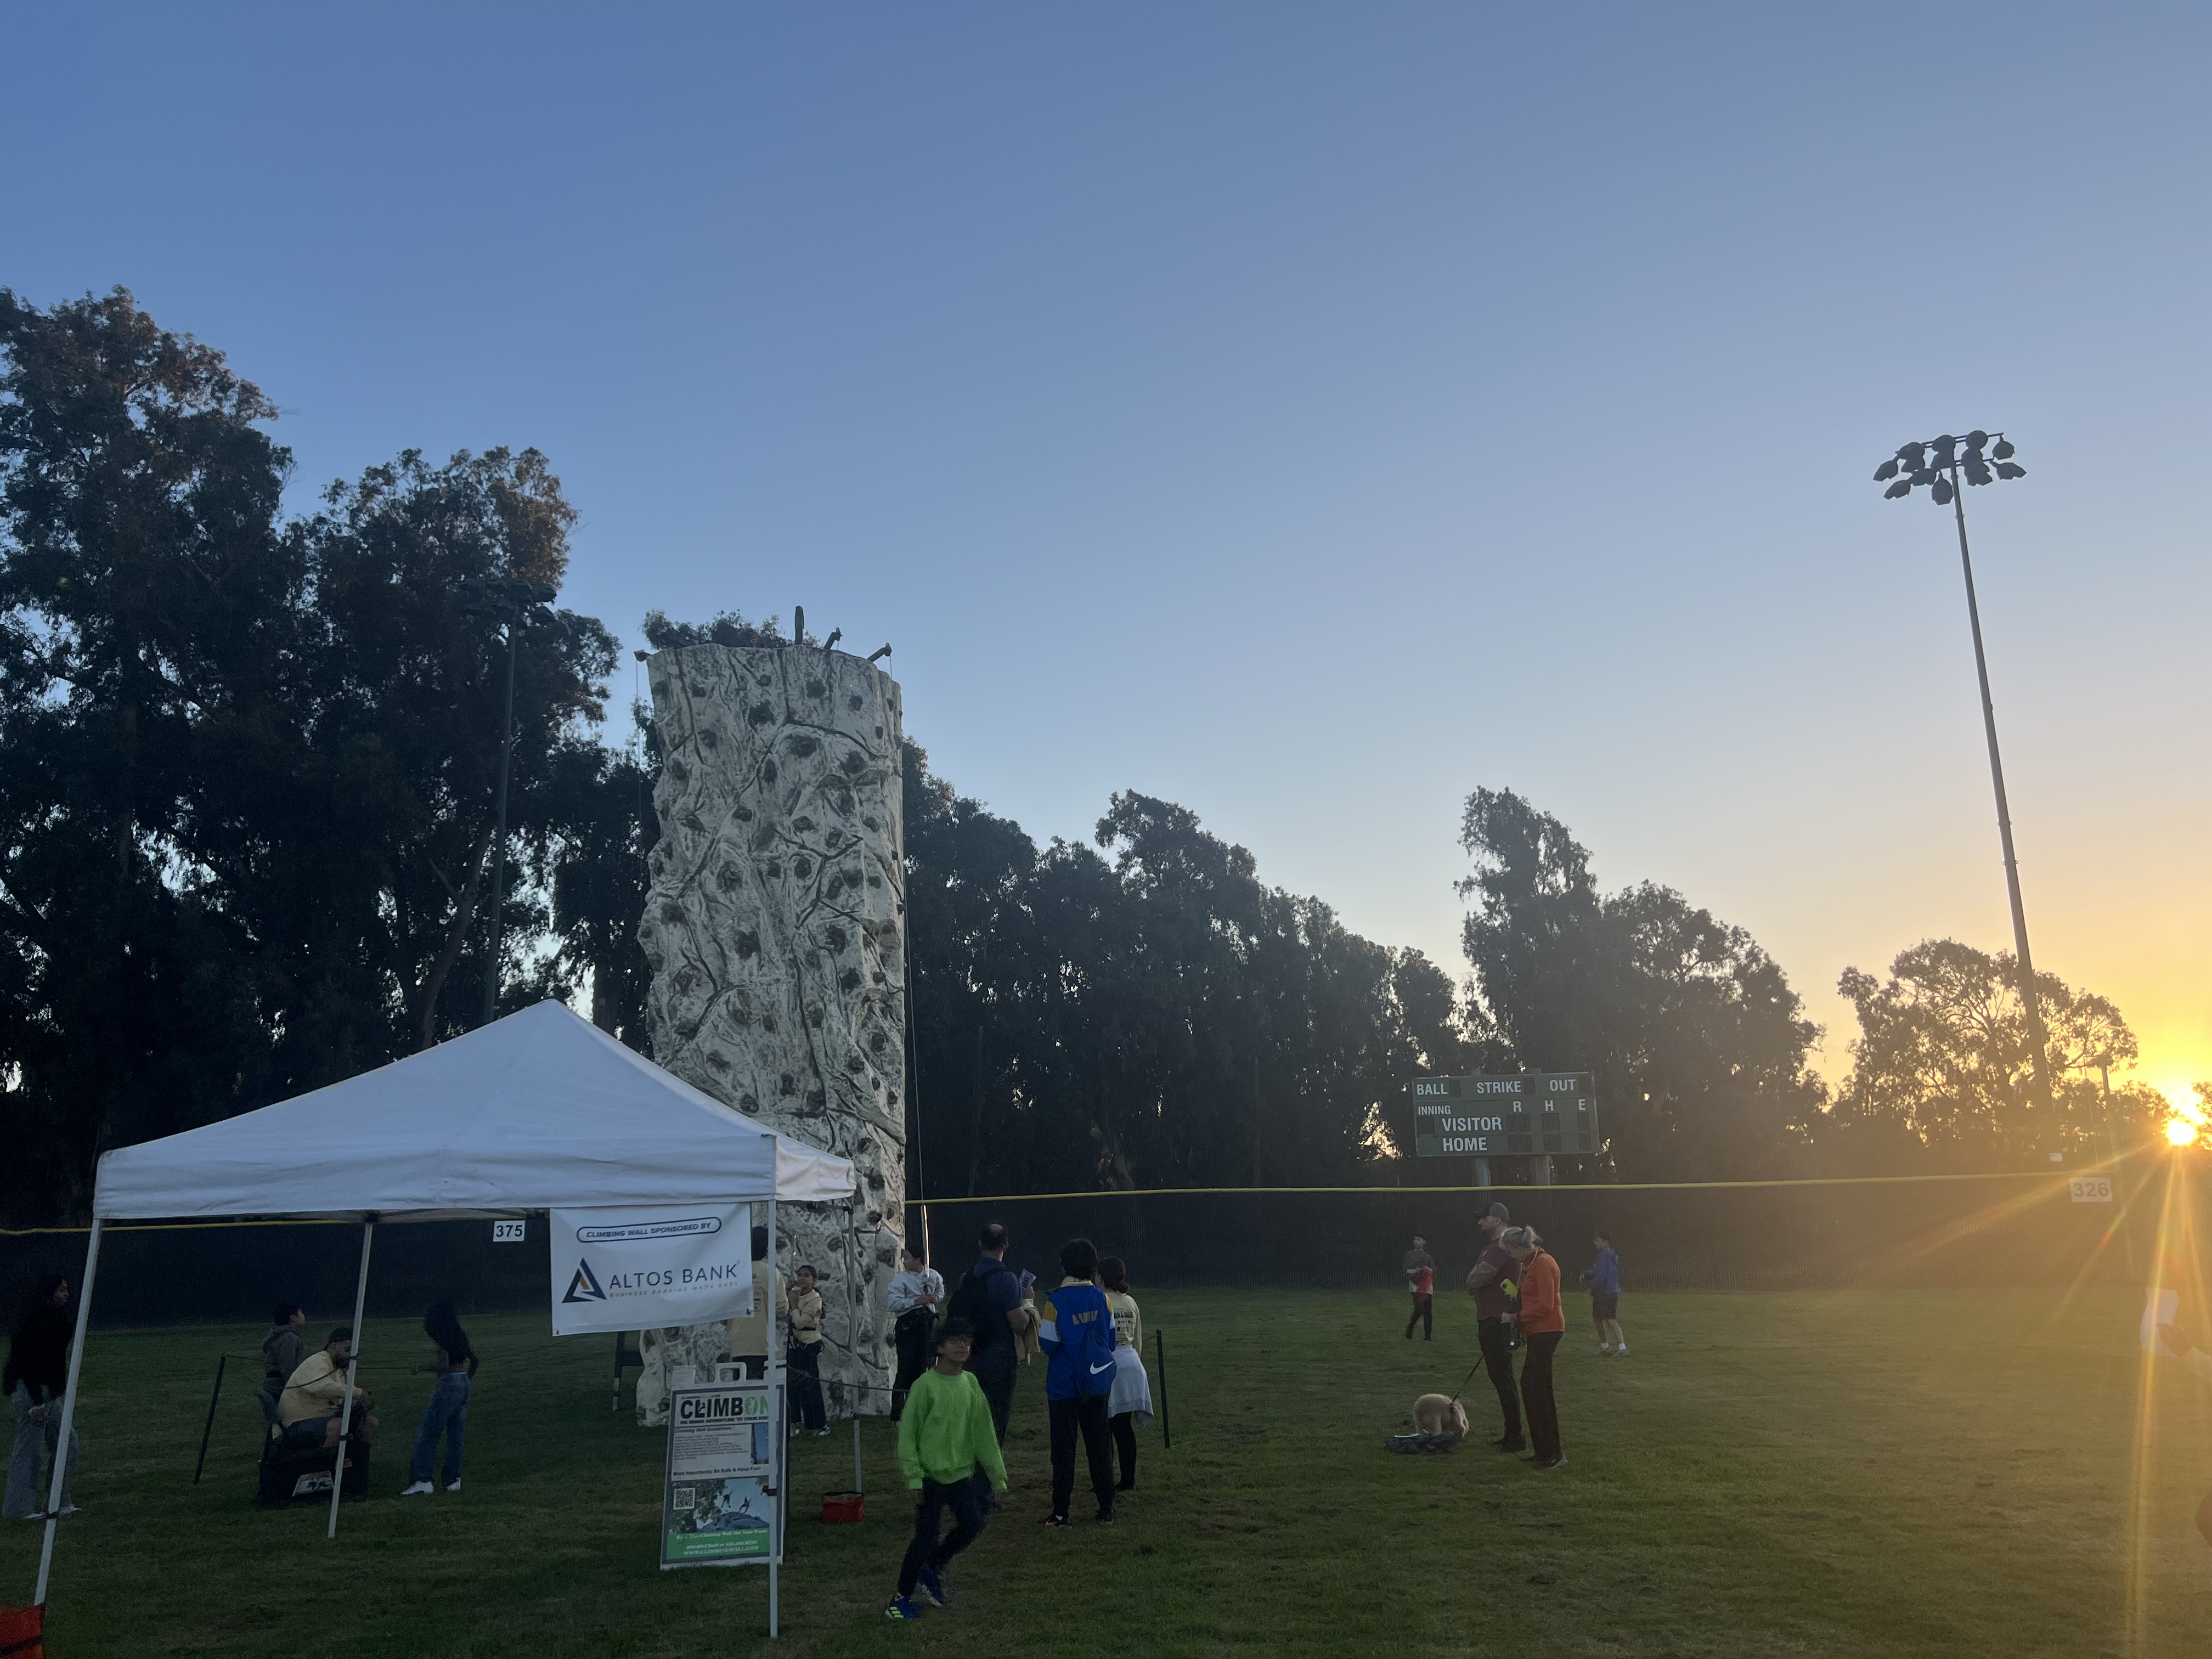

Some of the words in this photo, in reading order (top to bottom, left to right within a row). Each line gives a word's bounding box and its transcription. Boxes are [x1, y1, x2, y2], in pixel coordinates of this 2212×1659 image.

[1416, 1083, 1448, 1096] BALL
[1476, 1081, 1522, 1094] STRIKE
[1549, 1079, 1576, 1091] OUT
[1418, 1105, 1451, 1115] INNING
[1513, 1101, 1522, 1112] R
[1545, 1100, 1554, 1111] H
[1578, 1099, 1586, 1110] E
[1442, 1116, 1502, 1132] VISITOR
[1443, 1137, 1487, 1152] HOME
[2073, 1182, 2109, 1197] 326
[495, 1224, 523, 1237] 375
[586, 1230, 625, 1238] CLIMBING
[650, 1224, 699, 1234] SPONSORED
[609, 1270, 673, 1289] ALTOS
[682, 1263, 737, 1283] BANK
